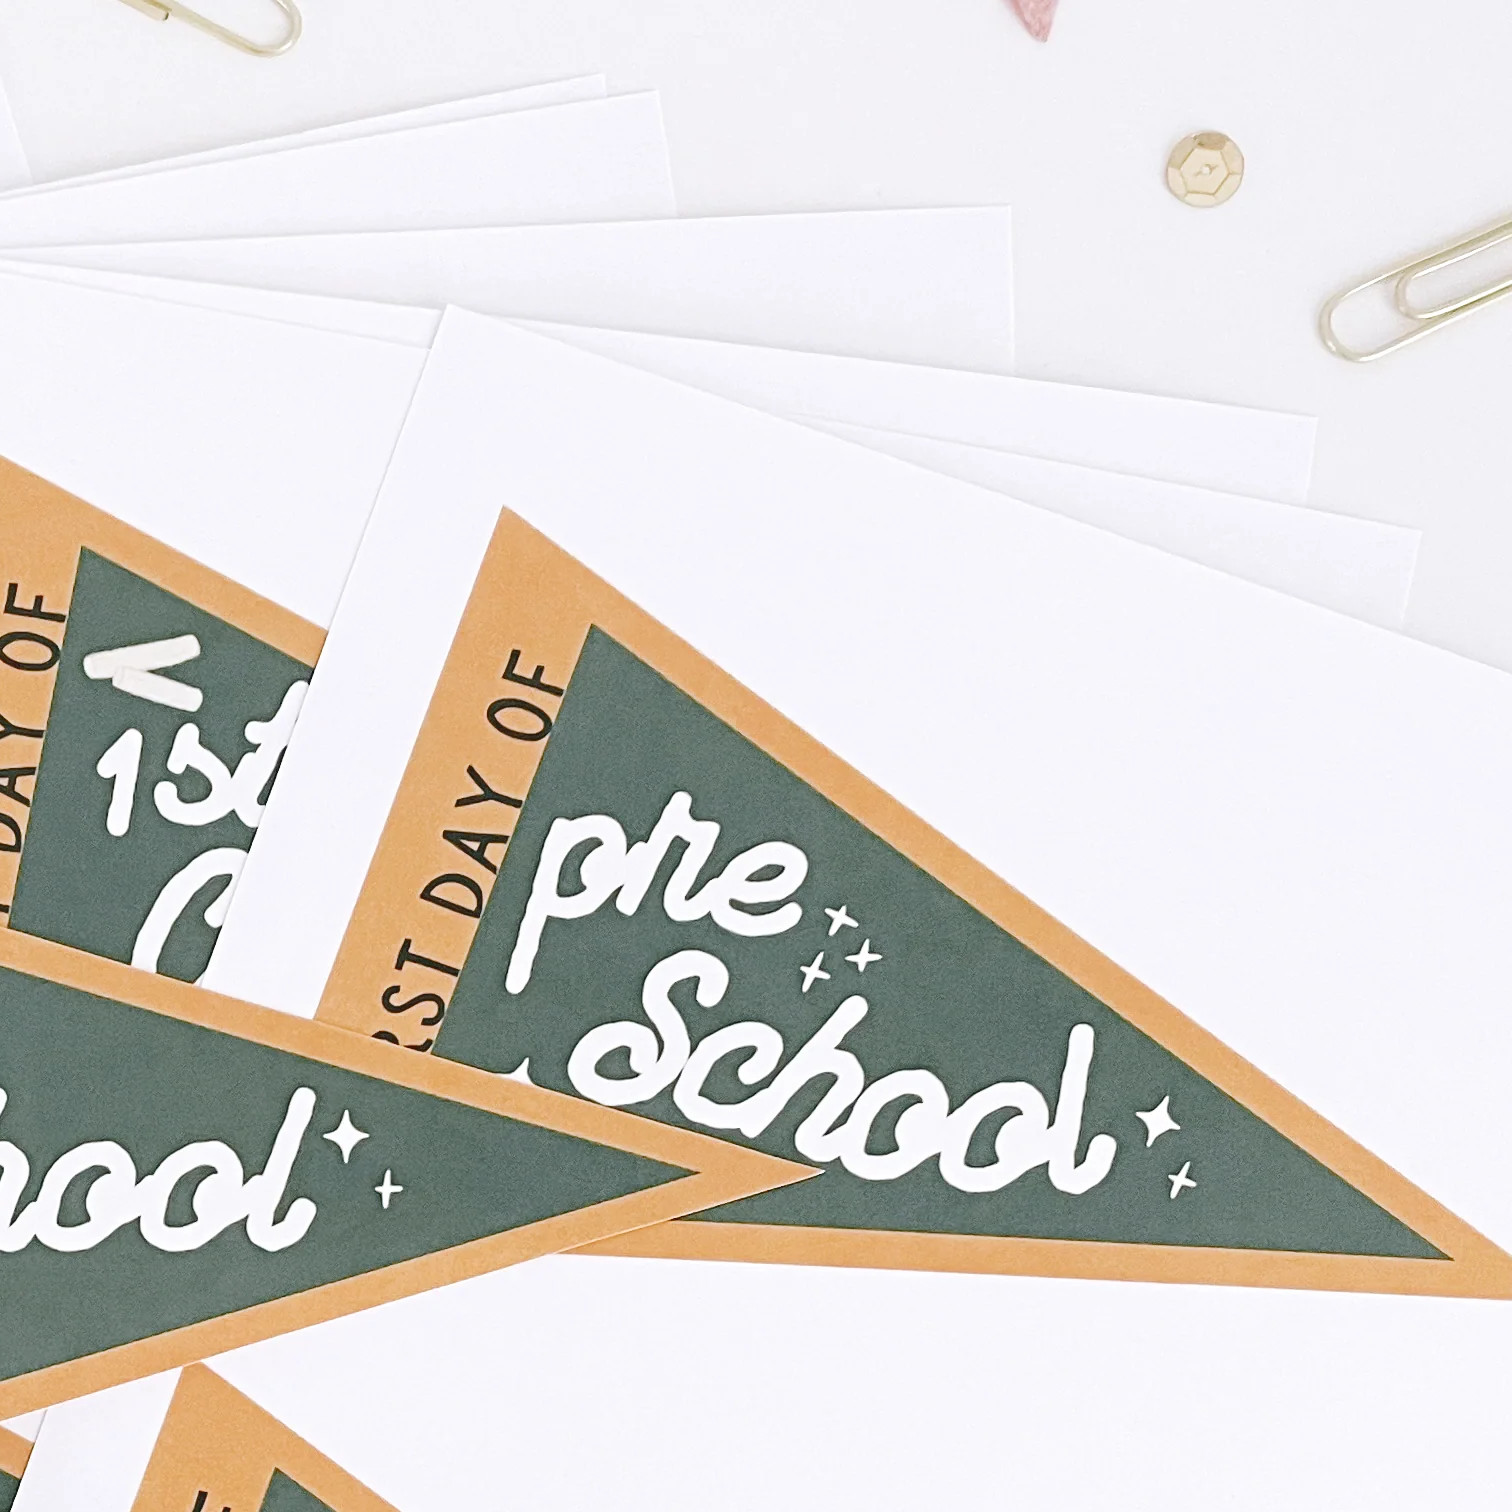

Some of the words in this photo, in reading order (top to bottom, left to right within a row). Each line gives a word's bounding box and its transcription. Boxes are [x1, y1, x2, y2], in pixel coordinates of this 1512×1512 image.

[420, 765, 522, 918] DAY
[486, 649, 564, 743] OF
[505, 791, 808, 994] pre
[567, 950, 1117, 1195] School
